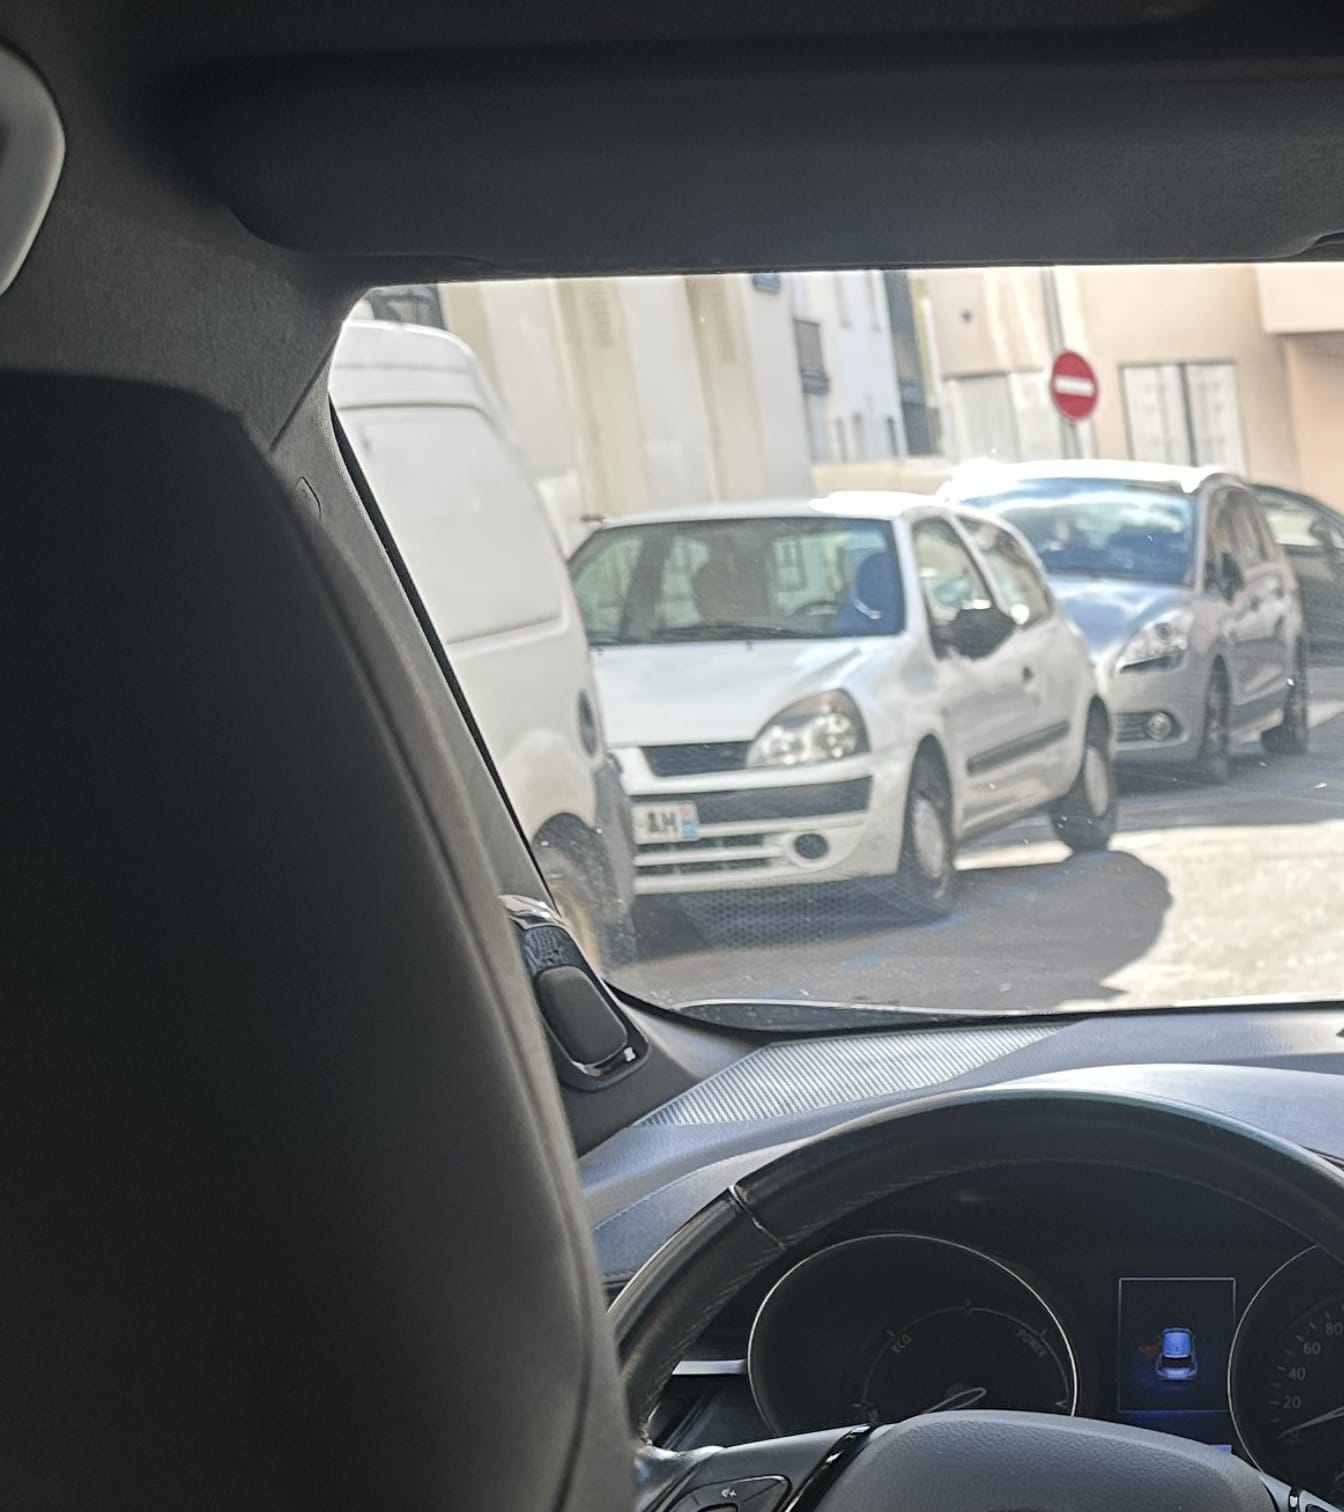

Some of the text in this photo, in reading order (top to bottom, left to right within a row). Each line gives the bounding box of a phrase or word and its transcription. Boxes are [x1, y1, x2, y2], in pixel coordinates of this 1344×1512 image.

[1325, 1322, 1343, 1336] 80
[1303, 1342, 1321, 1355] 60
[1288, 1367, 1307, 1381] 40
[1283, 1395, 1301, 1409] 20
